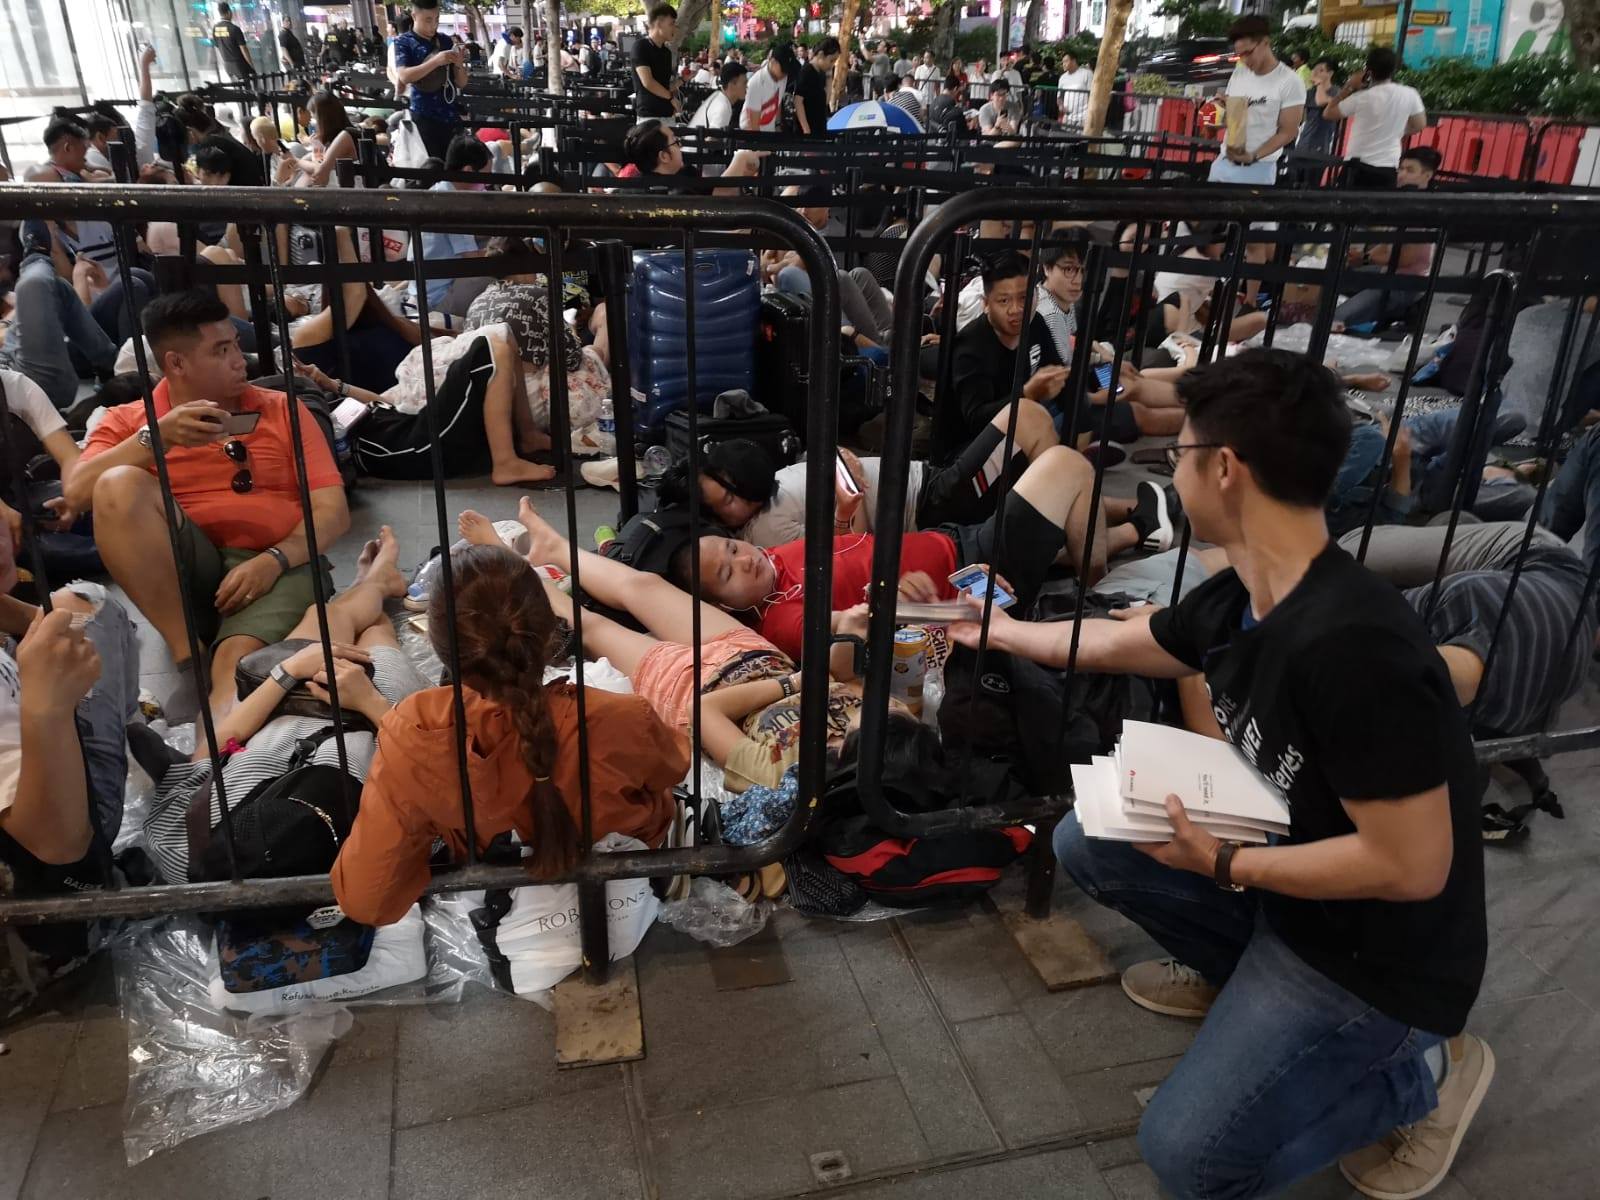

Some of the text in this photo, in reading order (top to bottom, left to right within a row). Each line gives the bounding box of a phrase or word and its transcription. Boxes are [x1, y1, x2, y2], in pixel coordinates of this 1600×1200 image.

[511, 288, 534, 302] John
[488, 299, 519, 313] Logan
[505, 308, 533, 321] Aiden
[1240, 715, 1264, 768] WEI
